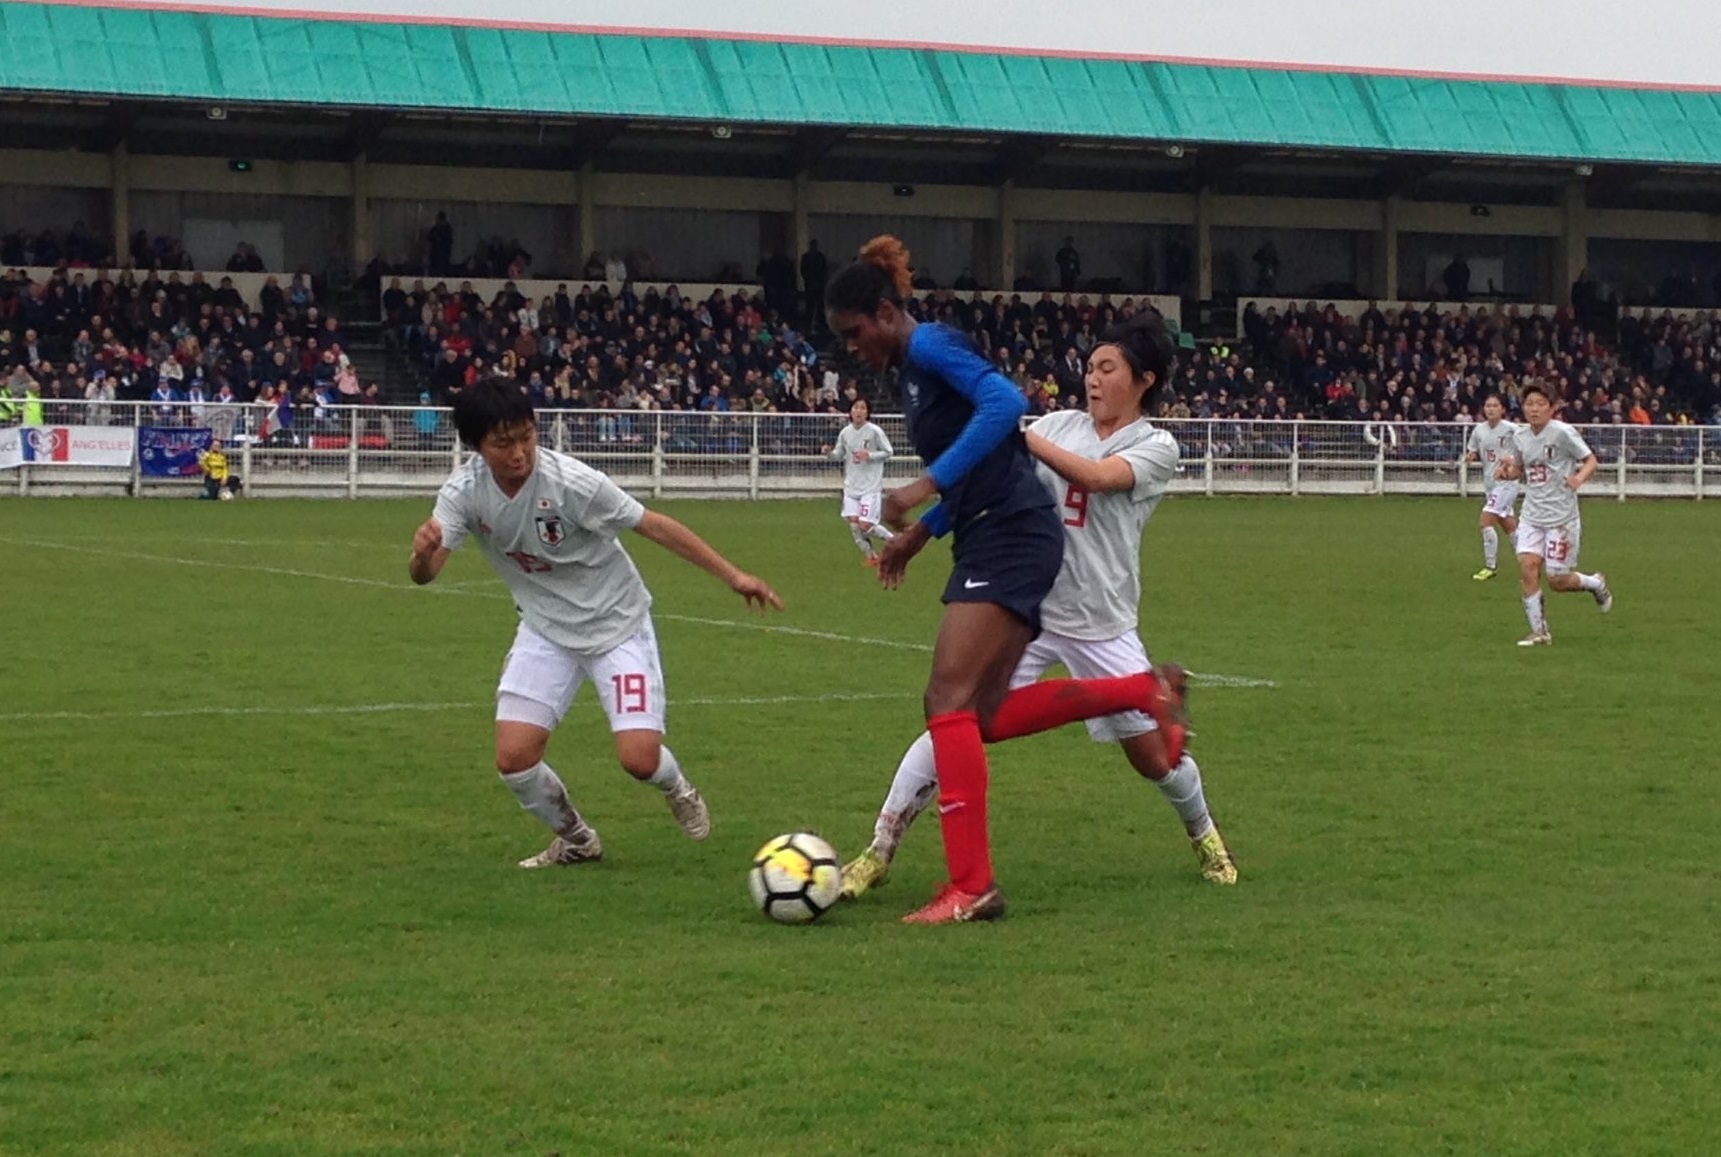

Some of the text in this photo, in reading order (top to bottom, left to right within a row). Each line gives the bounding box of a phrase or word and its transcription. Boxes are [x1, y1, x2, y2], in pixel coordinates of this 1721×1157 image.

[1064, 484, 1088, 527] 9
[1547, 541, 1567, 560] 23
[612, 674, 646, 714] 19
